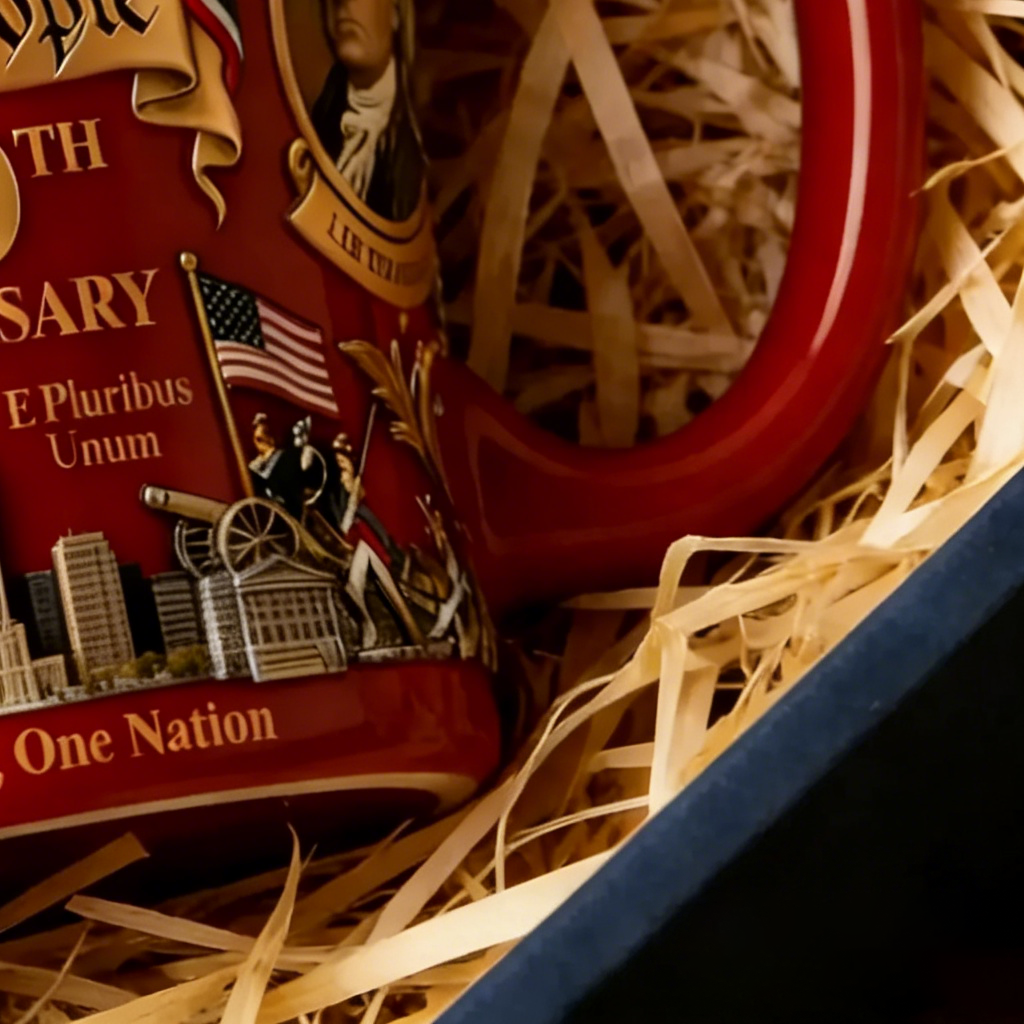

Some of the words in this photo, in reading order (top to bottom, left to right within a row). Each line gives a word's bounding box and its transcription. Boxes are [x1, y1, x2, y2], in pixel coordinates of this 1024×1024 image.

[2, 388, 37, 430] E
[38, 371, 195, 423] Pluribus
[45, 429, 163, 470] Unum
[13, 723, 114, 775] One
[123, 699, 279, 758] Nation
